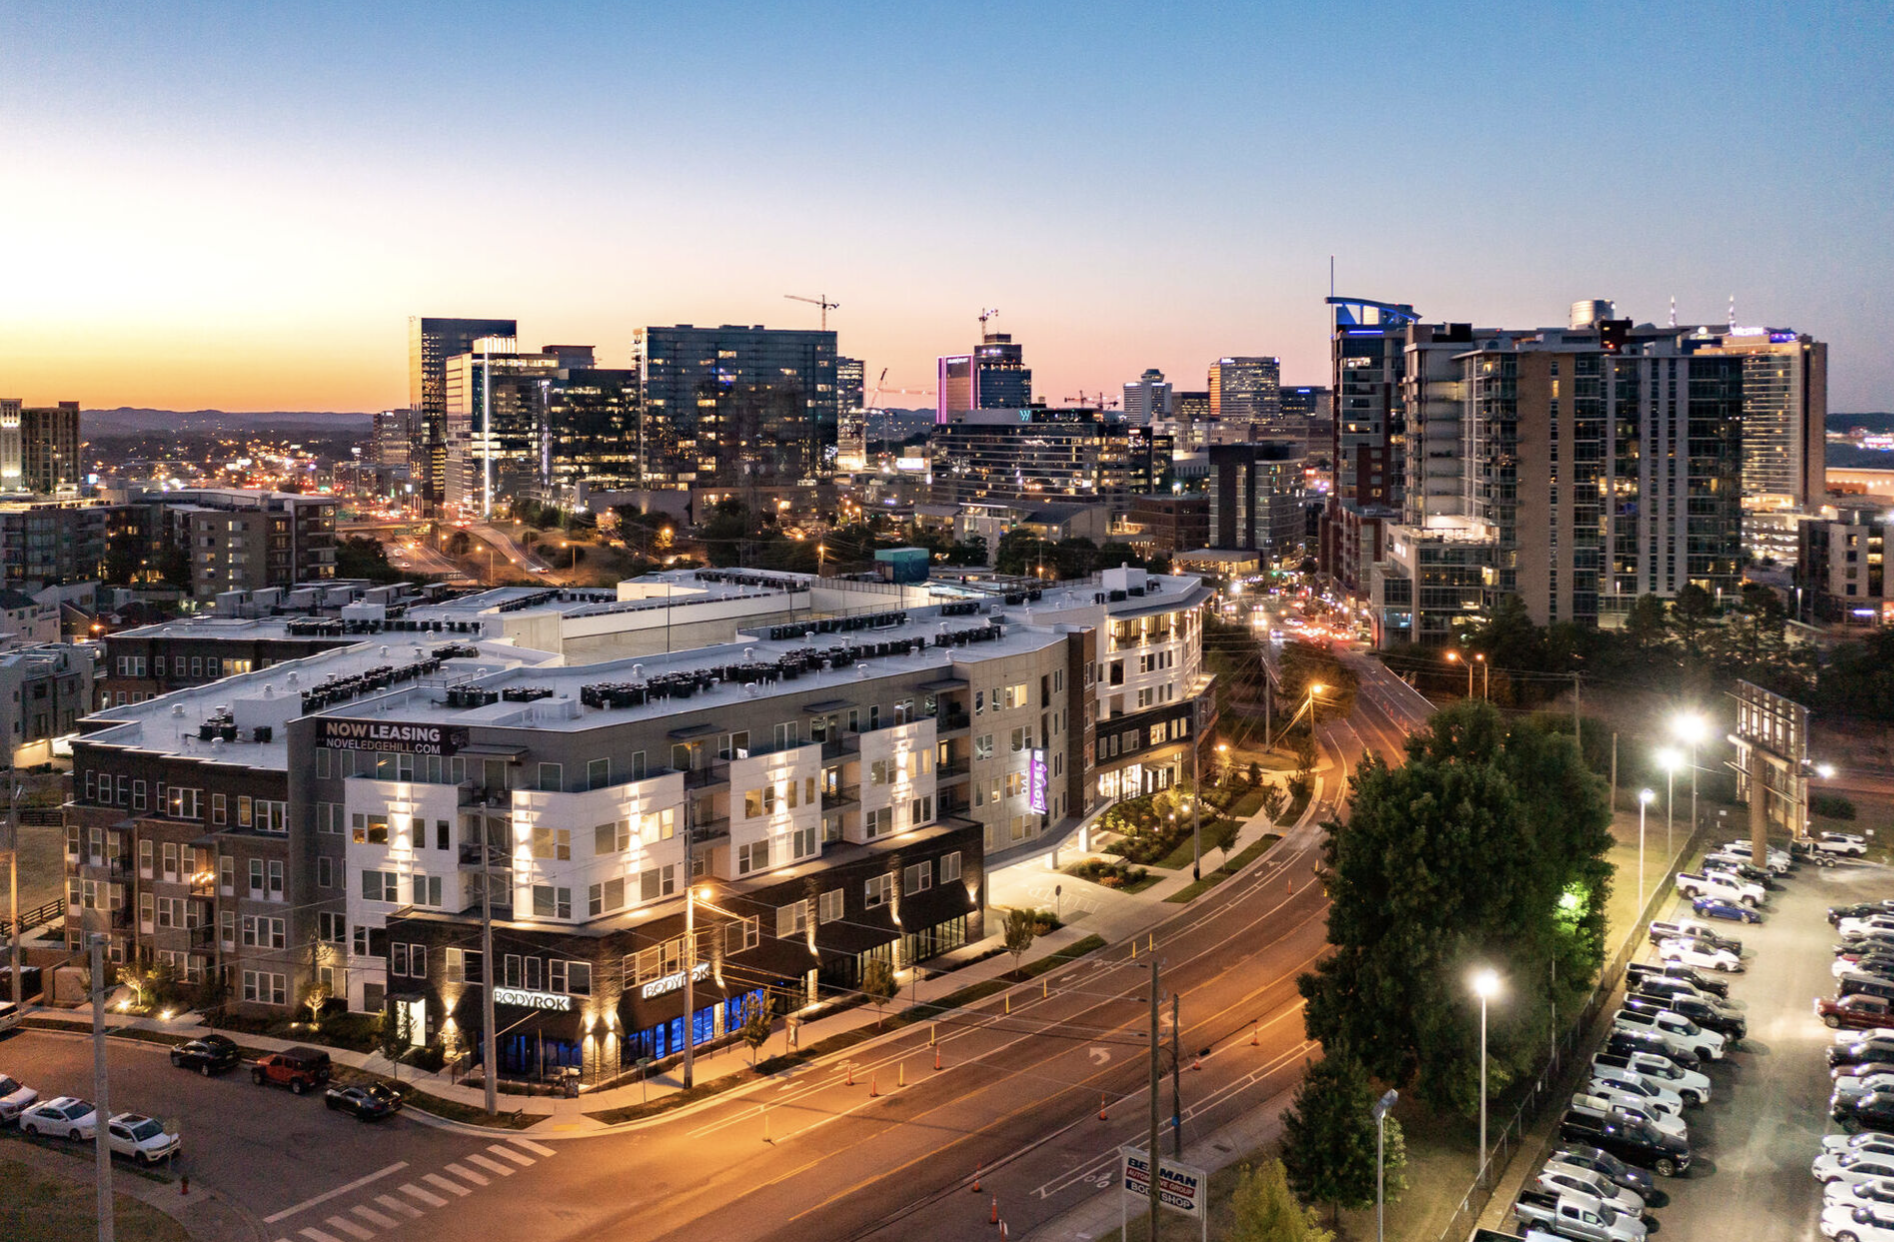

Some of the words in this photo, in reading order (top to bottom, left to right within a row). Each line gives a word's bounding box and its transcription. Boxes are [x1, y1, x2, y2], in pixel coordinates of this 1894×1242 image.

[326, 722, 367, 737] NOW
[369, 724, 441, 742] LEASING
[326, 737, 441, 754] NOVELEDGEHILL.COM
[1034, 763, 1043, 809] NOVEL
[494, 991, 567, 1011] BODYROK
[1127, 1169, 1168, 1188] AUTOMVE
[1169, 1183, 1193, 1195] GROUP
[1128, 1157, 1197, 1188] BEMAN
[1131, 1182, 1151, 1196] BOD
[1161, 1193, 1190, 1207] SHOP
